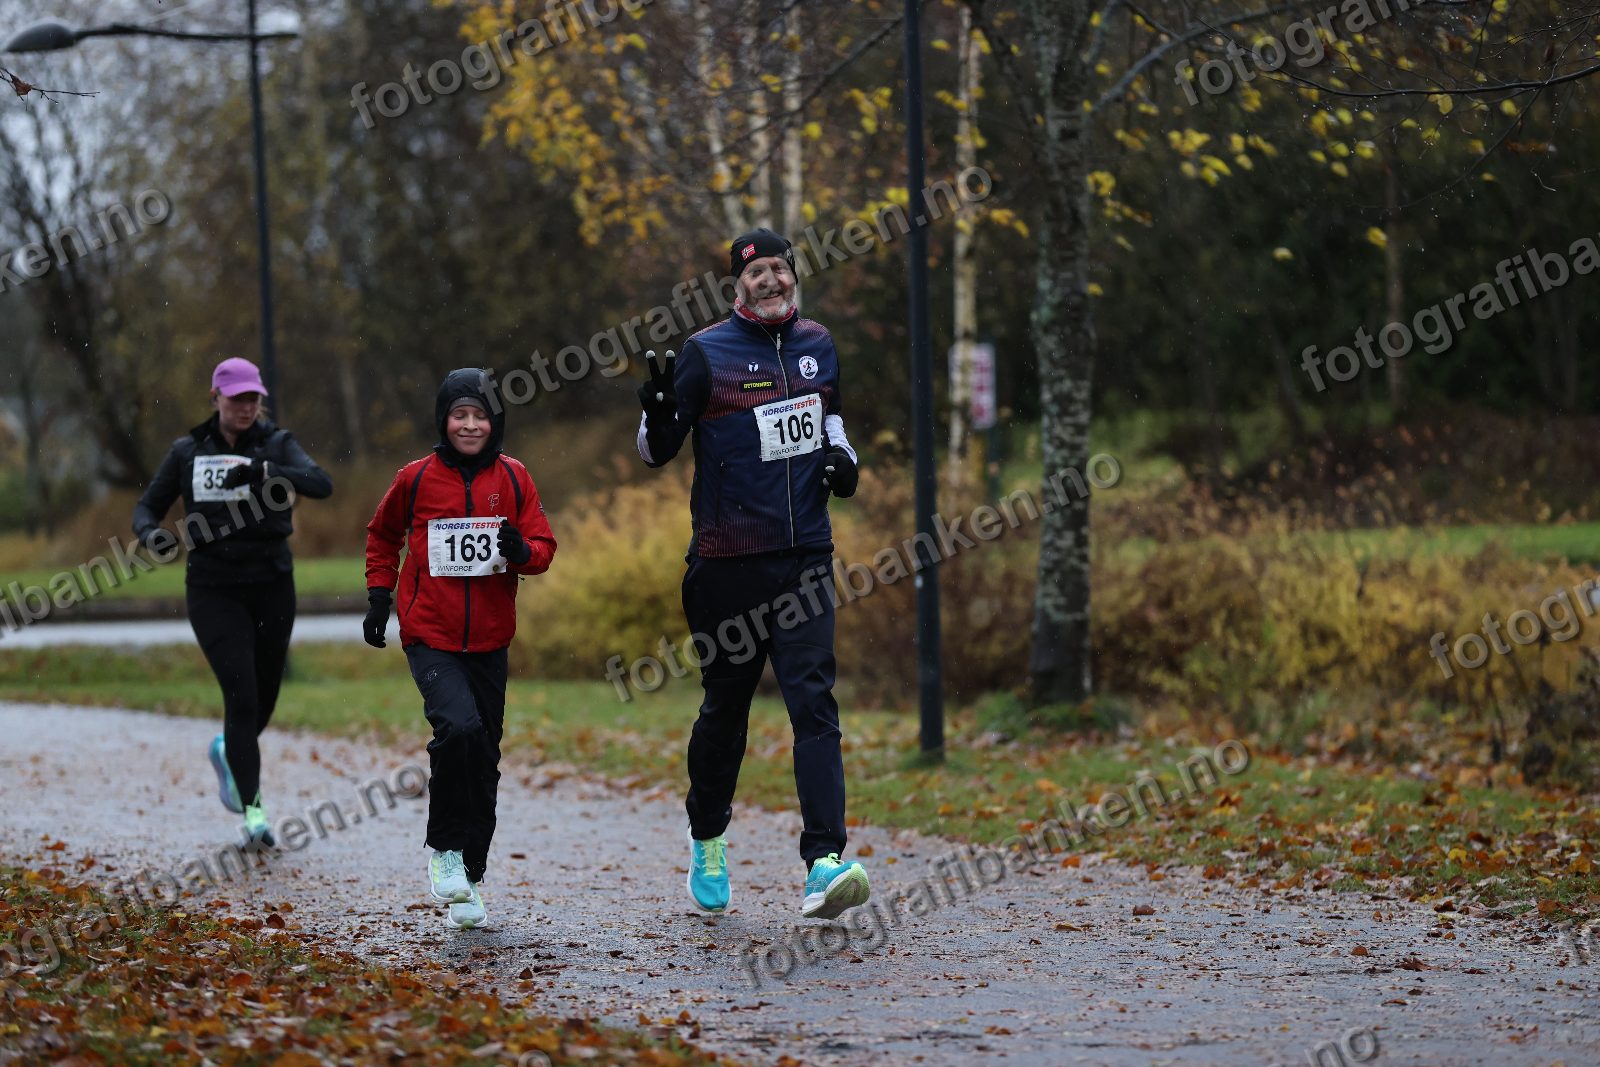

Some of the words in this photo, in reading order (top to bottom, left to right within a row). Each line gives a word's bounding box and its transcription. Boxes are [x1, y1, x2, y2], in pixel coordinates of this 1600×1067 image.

[762, 399, 817, 417] NORGESTESTEN
[774, 412, 814, 445] 106
[203, 469, 226, 490] 35
[434, 521, 502, 531] NORGESTESTEN
[445, 533, 492, 562] 163
